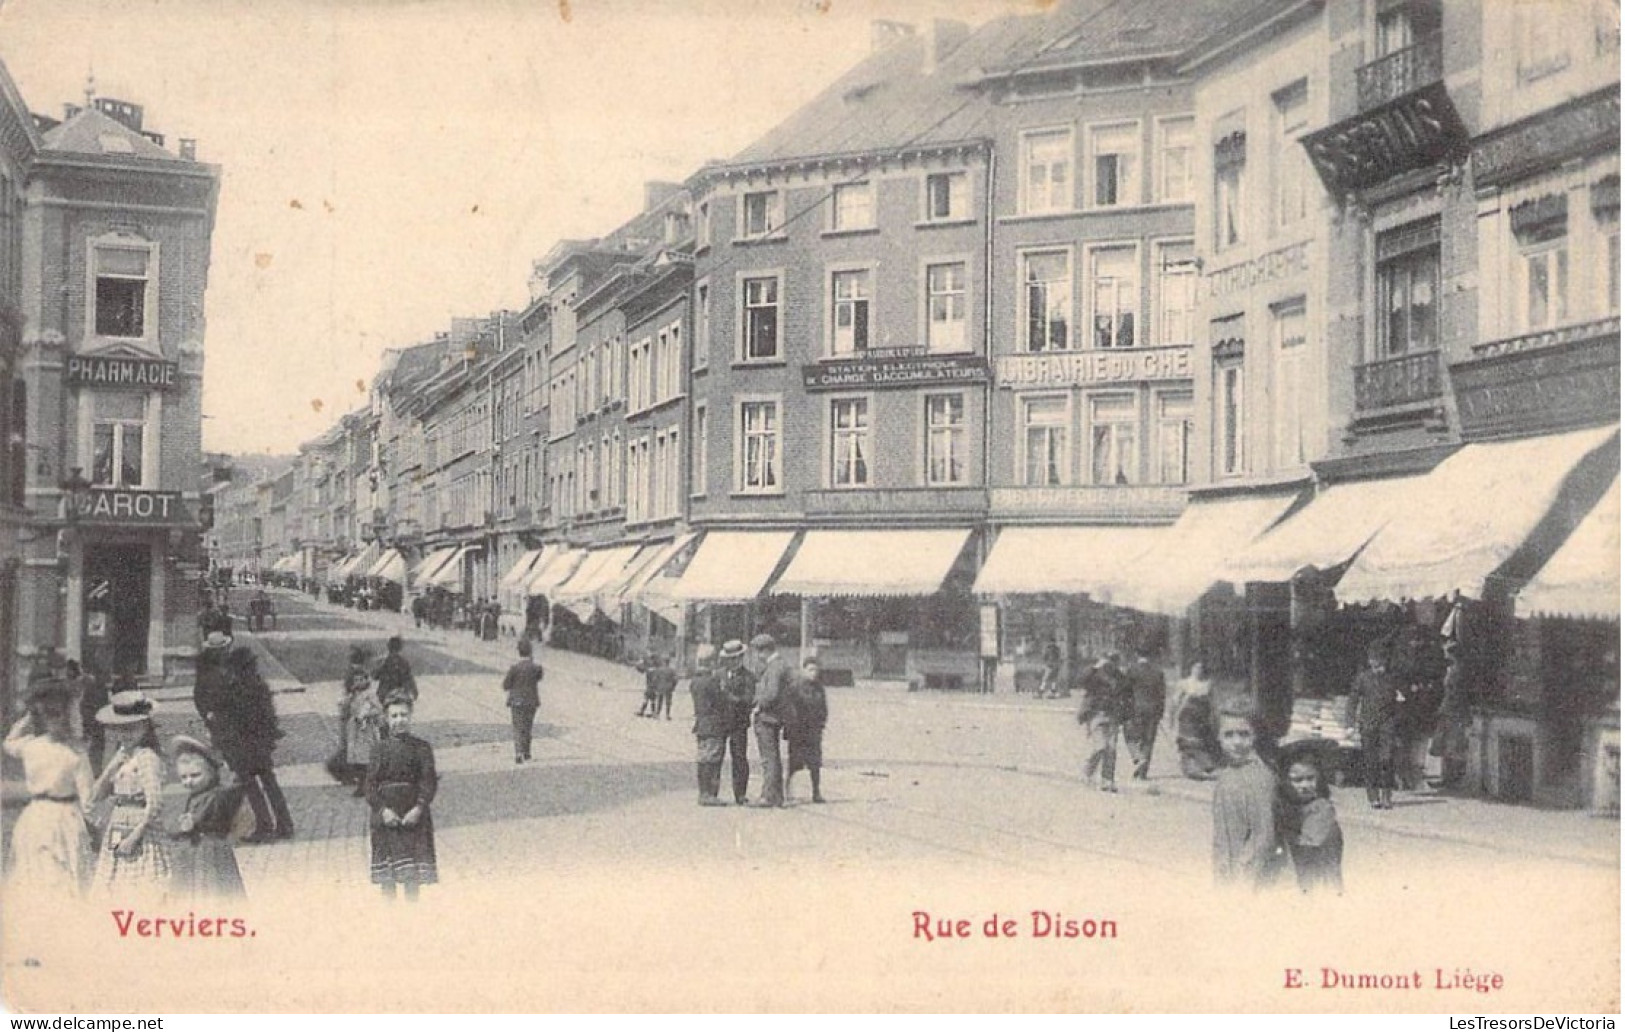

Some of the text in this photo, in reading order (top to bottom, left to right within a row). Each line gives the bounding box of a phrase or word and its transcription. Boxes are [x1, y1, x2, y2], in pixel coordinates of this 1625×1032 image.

[69, 359, 175, 385] PHARMACIE
[828, 365, 877, 374] STATION
[1000, 355, 1108, 383] LIBRAIRIE
[821, 374, 866, 384] CHARGE
